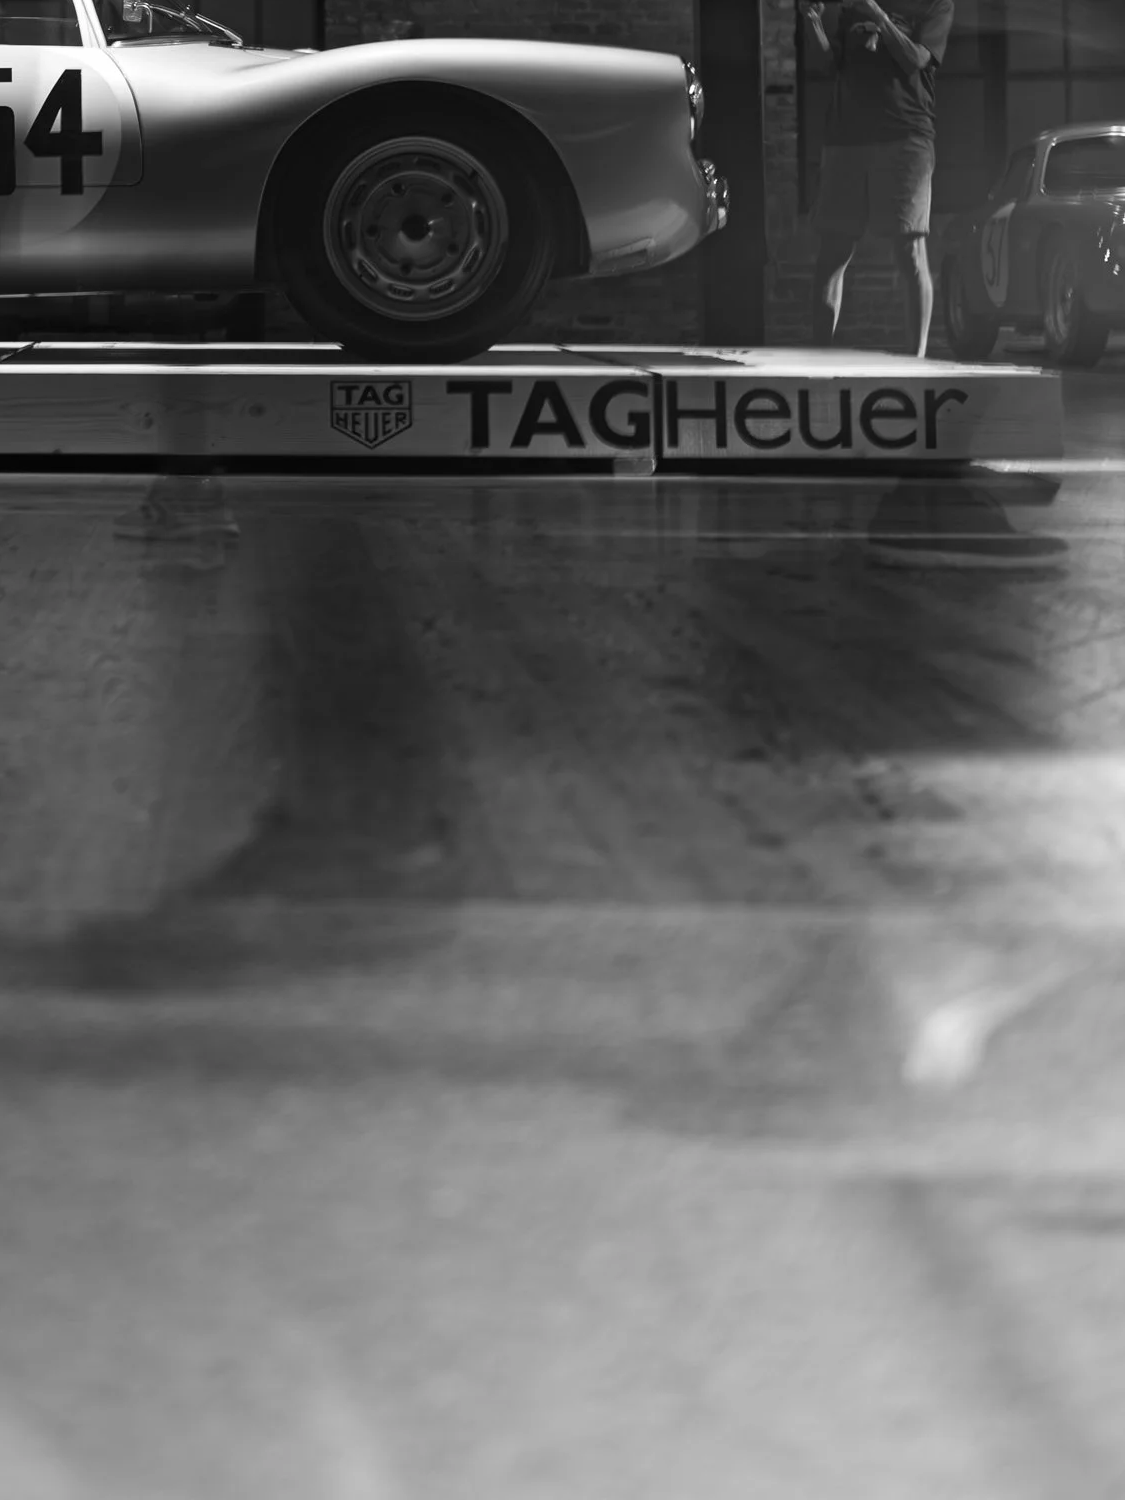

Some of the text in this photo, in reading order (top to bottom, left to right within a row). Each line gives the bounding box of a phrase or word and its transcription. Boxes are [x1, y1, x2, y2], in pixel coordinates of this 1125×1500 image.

[337, 384, 404, 406] TAG
[335, 412, 407, 444] HEUER
[446, 380, 969, 450] TAG Heuer
